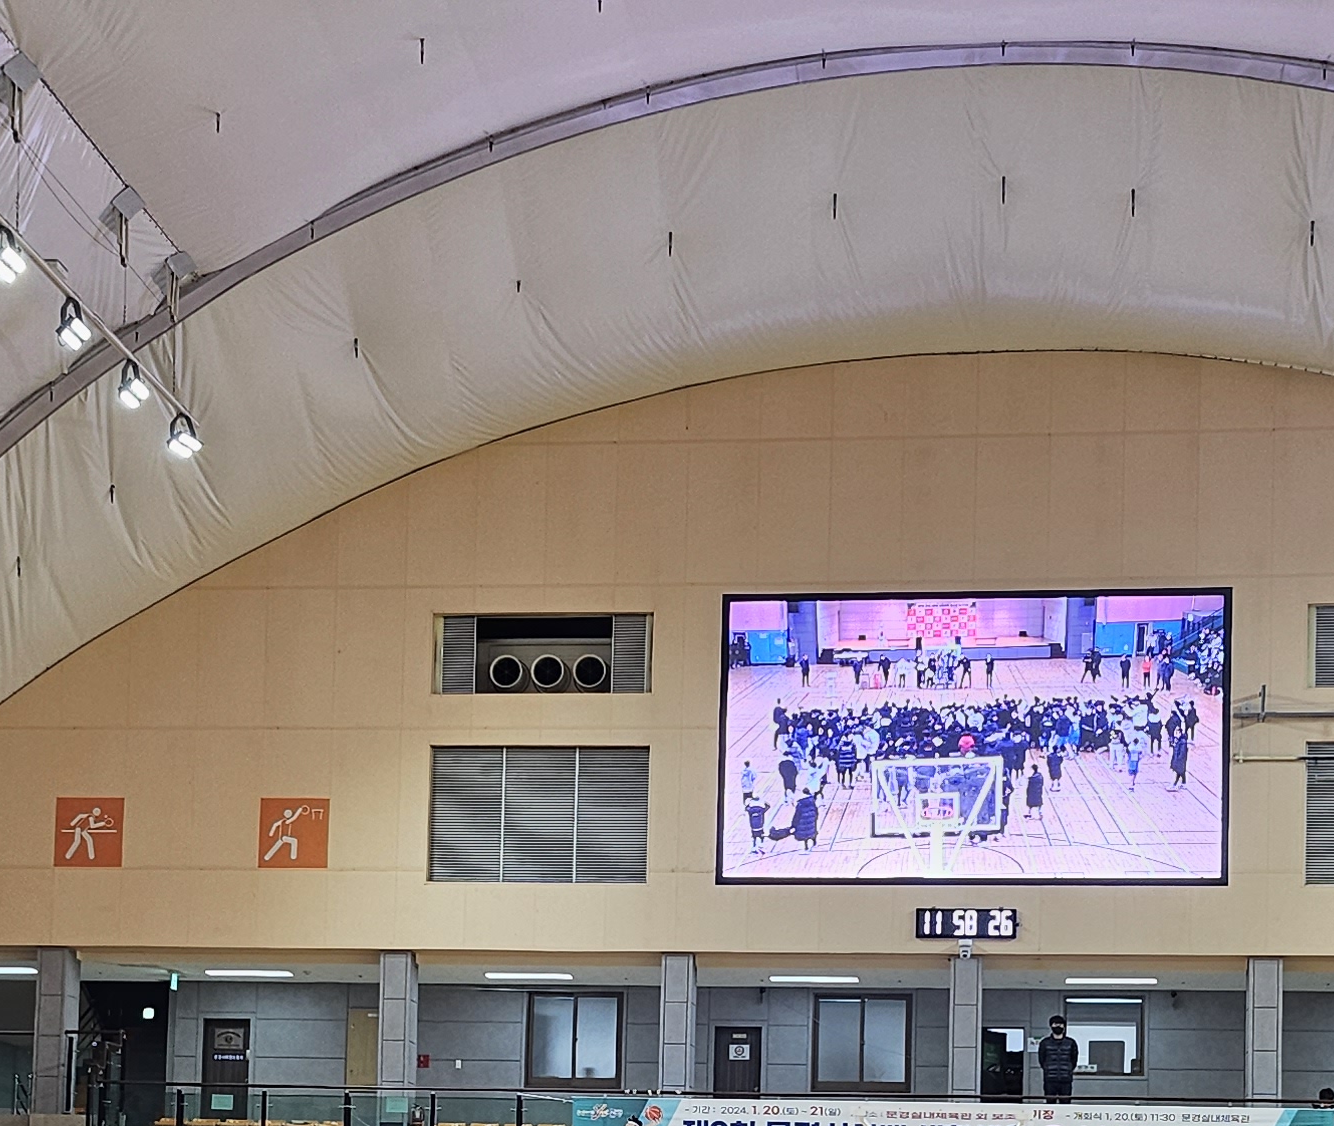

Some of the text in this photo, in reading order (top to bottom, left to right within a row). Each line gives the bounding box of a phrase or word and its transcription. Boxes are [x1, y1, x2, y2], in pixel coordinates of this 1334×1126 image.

[924, 910, 1013, 936] 11 58 26
[1073, 1111, 1102, 1121] 개회식
[1150, 1113, 1176, 1122] 11:30
[1181, 1113, 1250, 1124] 문경실내체육관
